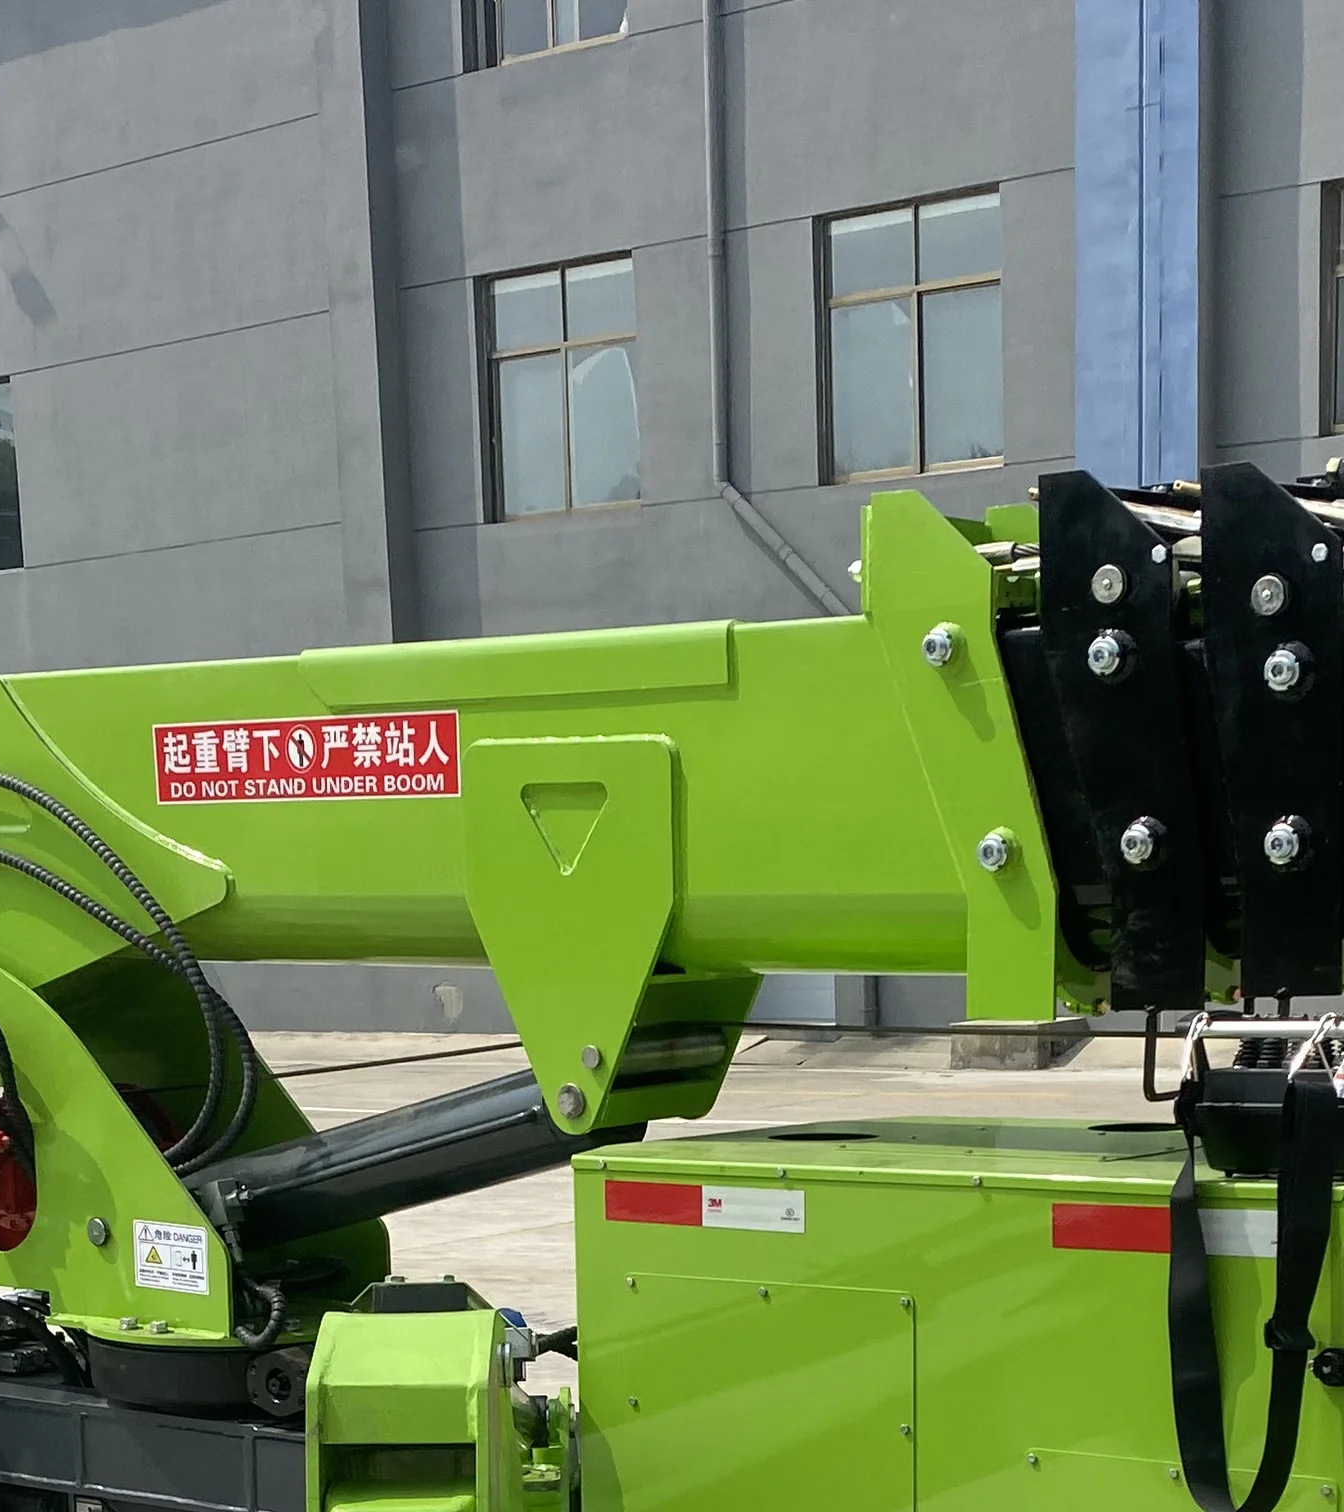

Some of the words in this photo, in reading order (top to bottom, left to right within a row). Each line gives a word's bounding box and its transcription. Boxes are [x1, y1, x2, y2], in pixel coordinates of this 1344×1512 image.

[163, 728, 281, 774] 起重臂下
[321, 720, 450, 769] 严禁站人
[170, 781, 197, 798] DO
[201, 780, 240, 797] NOT
[244, 778, 306, 796] STAND
[312, 775, 378, 794] UNDER
[384, 773, 445, 793] BOOM
[708, 1198, 722, 1208] 3M
[173, 1232, 203, 1244] DANGER
